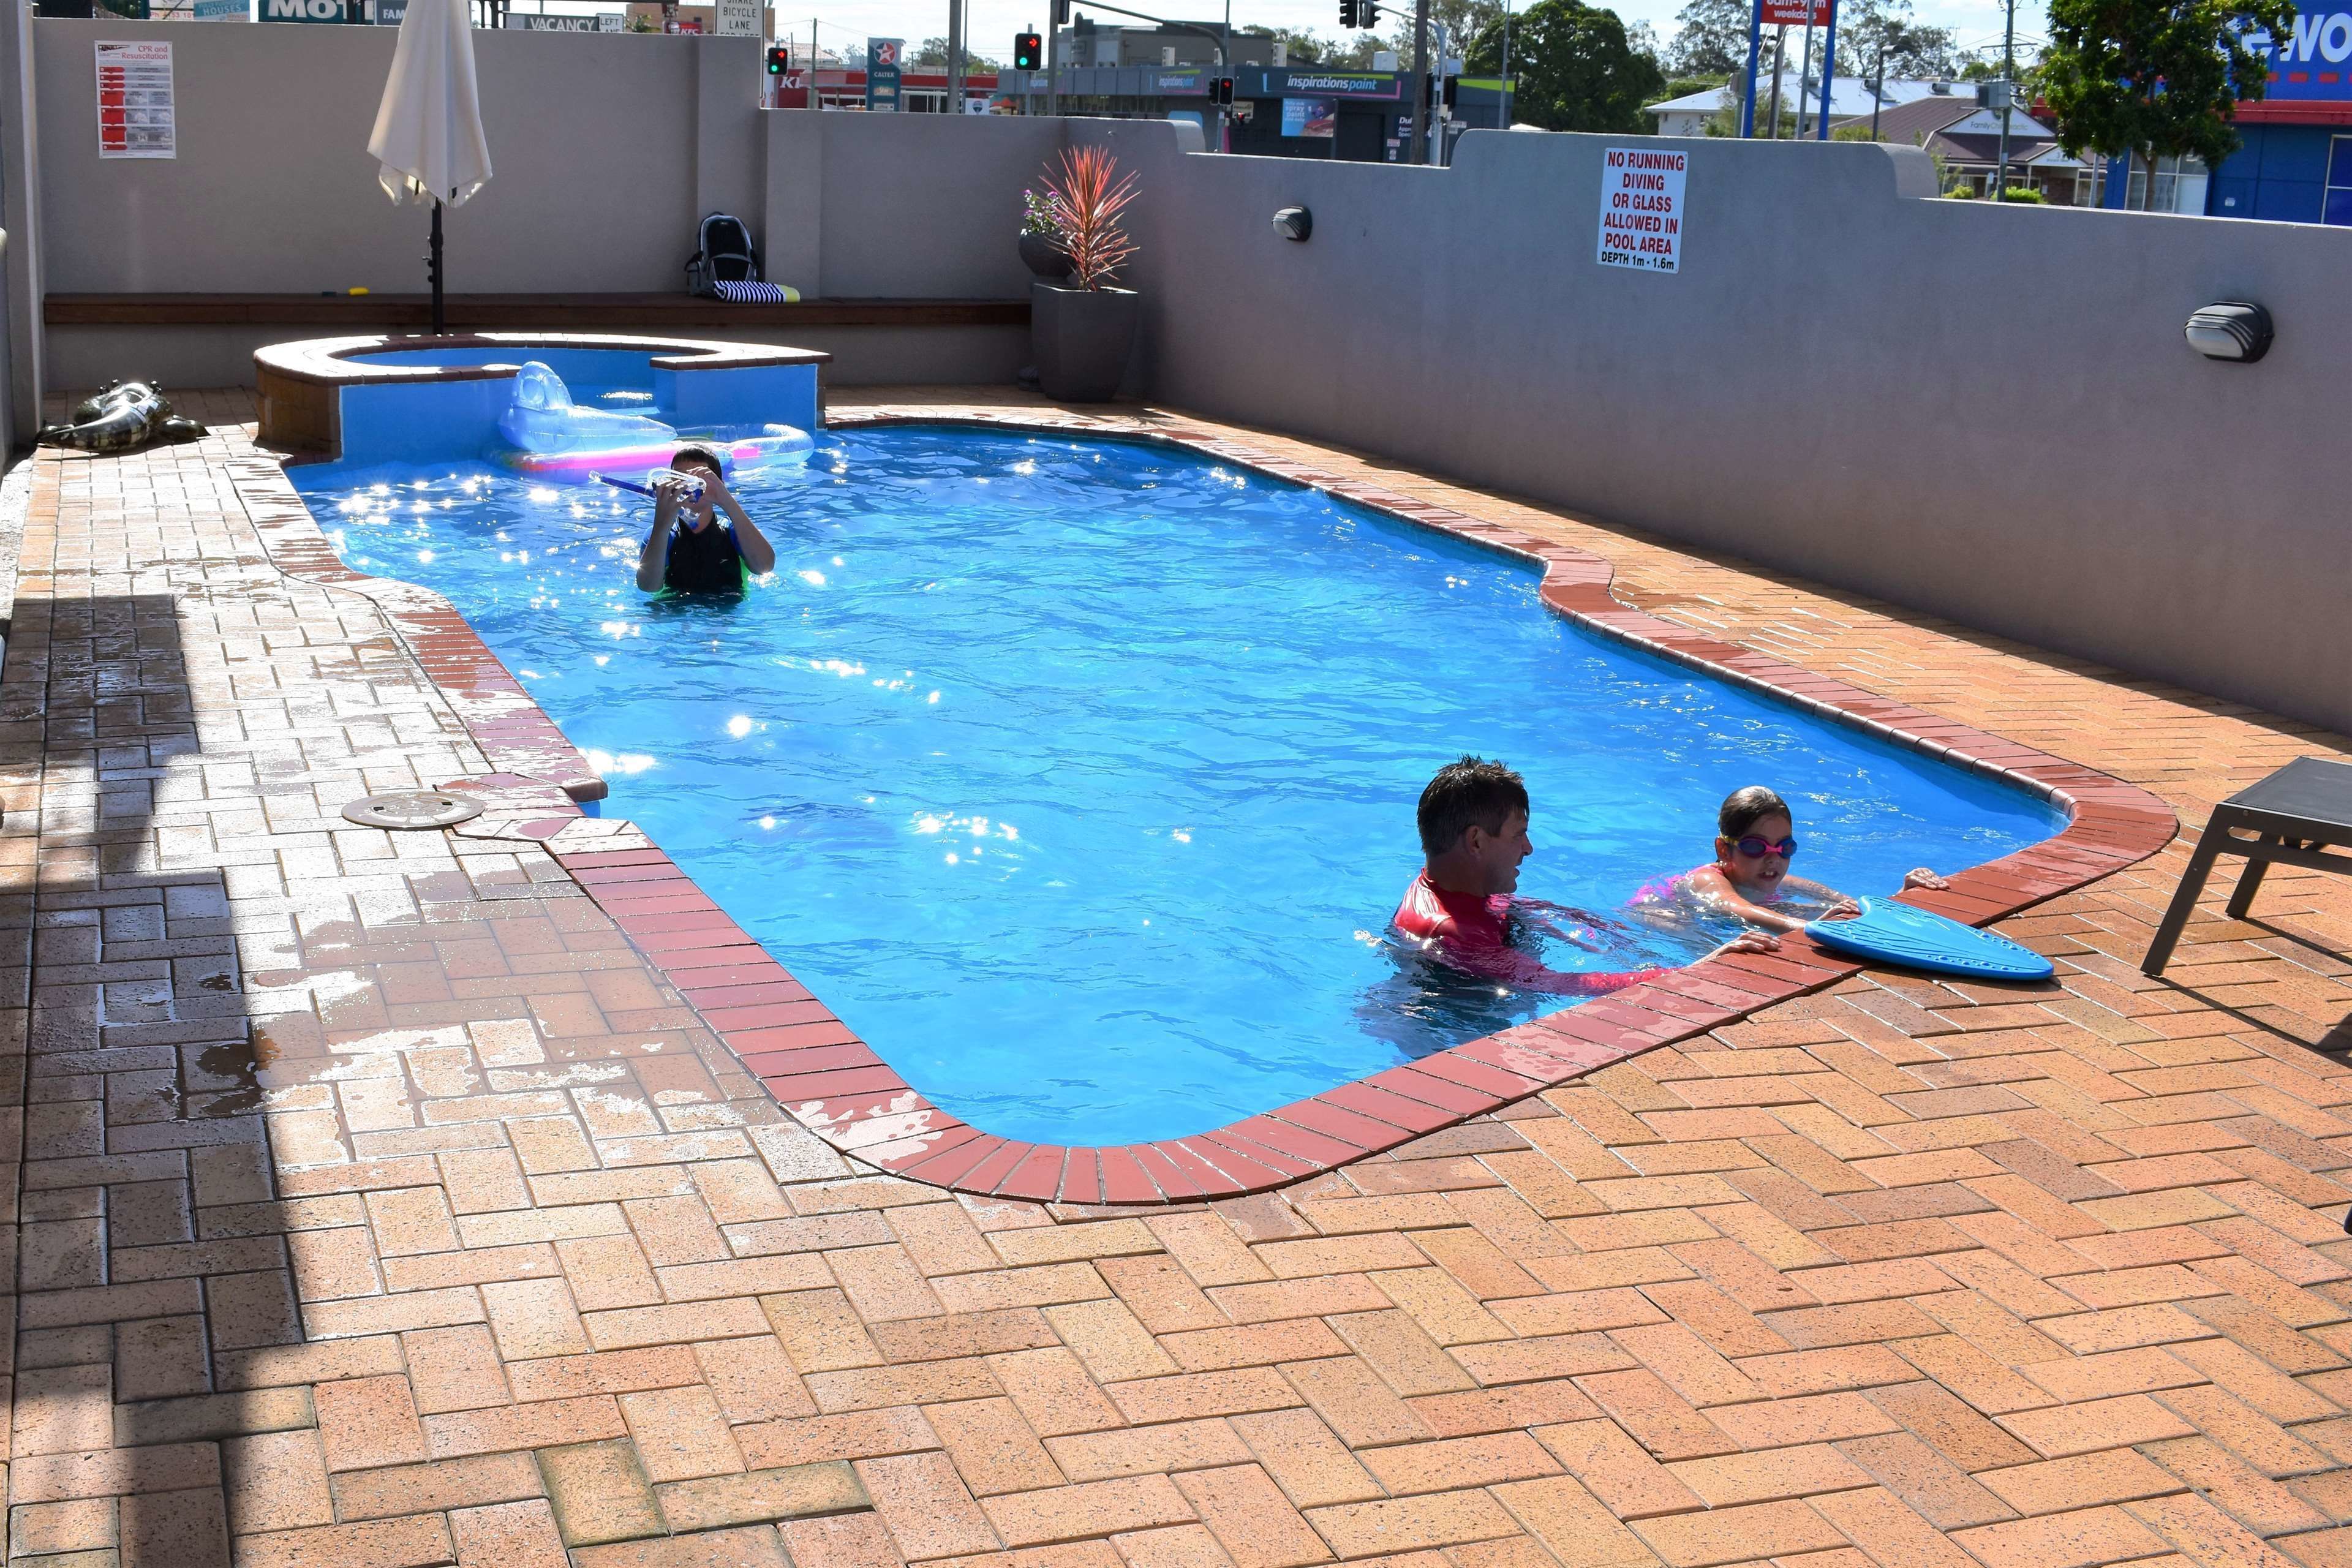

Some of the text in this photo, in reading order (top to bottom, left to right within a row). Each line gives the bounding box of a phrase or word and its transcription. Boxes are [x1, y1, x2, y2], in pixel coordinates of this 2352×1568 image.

[203, 5, 241, 15] HOUSES
[383, 9, 405, 19] FAM
[723, 7, 756, 18] BICYCLE
[1774, 9, 1817, 19] weekdas
[529, 18, 595, 31] VACANCY
[729, 20, 750, 29] LANE
[1608, 151, 1684, 171] NO RUNNING
[1623, 173, 1665, 190] DIVING
[1613, 192, 1672, 213] OR GLASS
[1604, 213, 1678, 234] ALLOWED IN
[1605, 233, 1672, 255] POOL AREA
[1602, 251, 1629, 265] DEPTH
[1632, 255, 1645, 266] 1m
[1653, 257, 1675, 270] 1.6m
